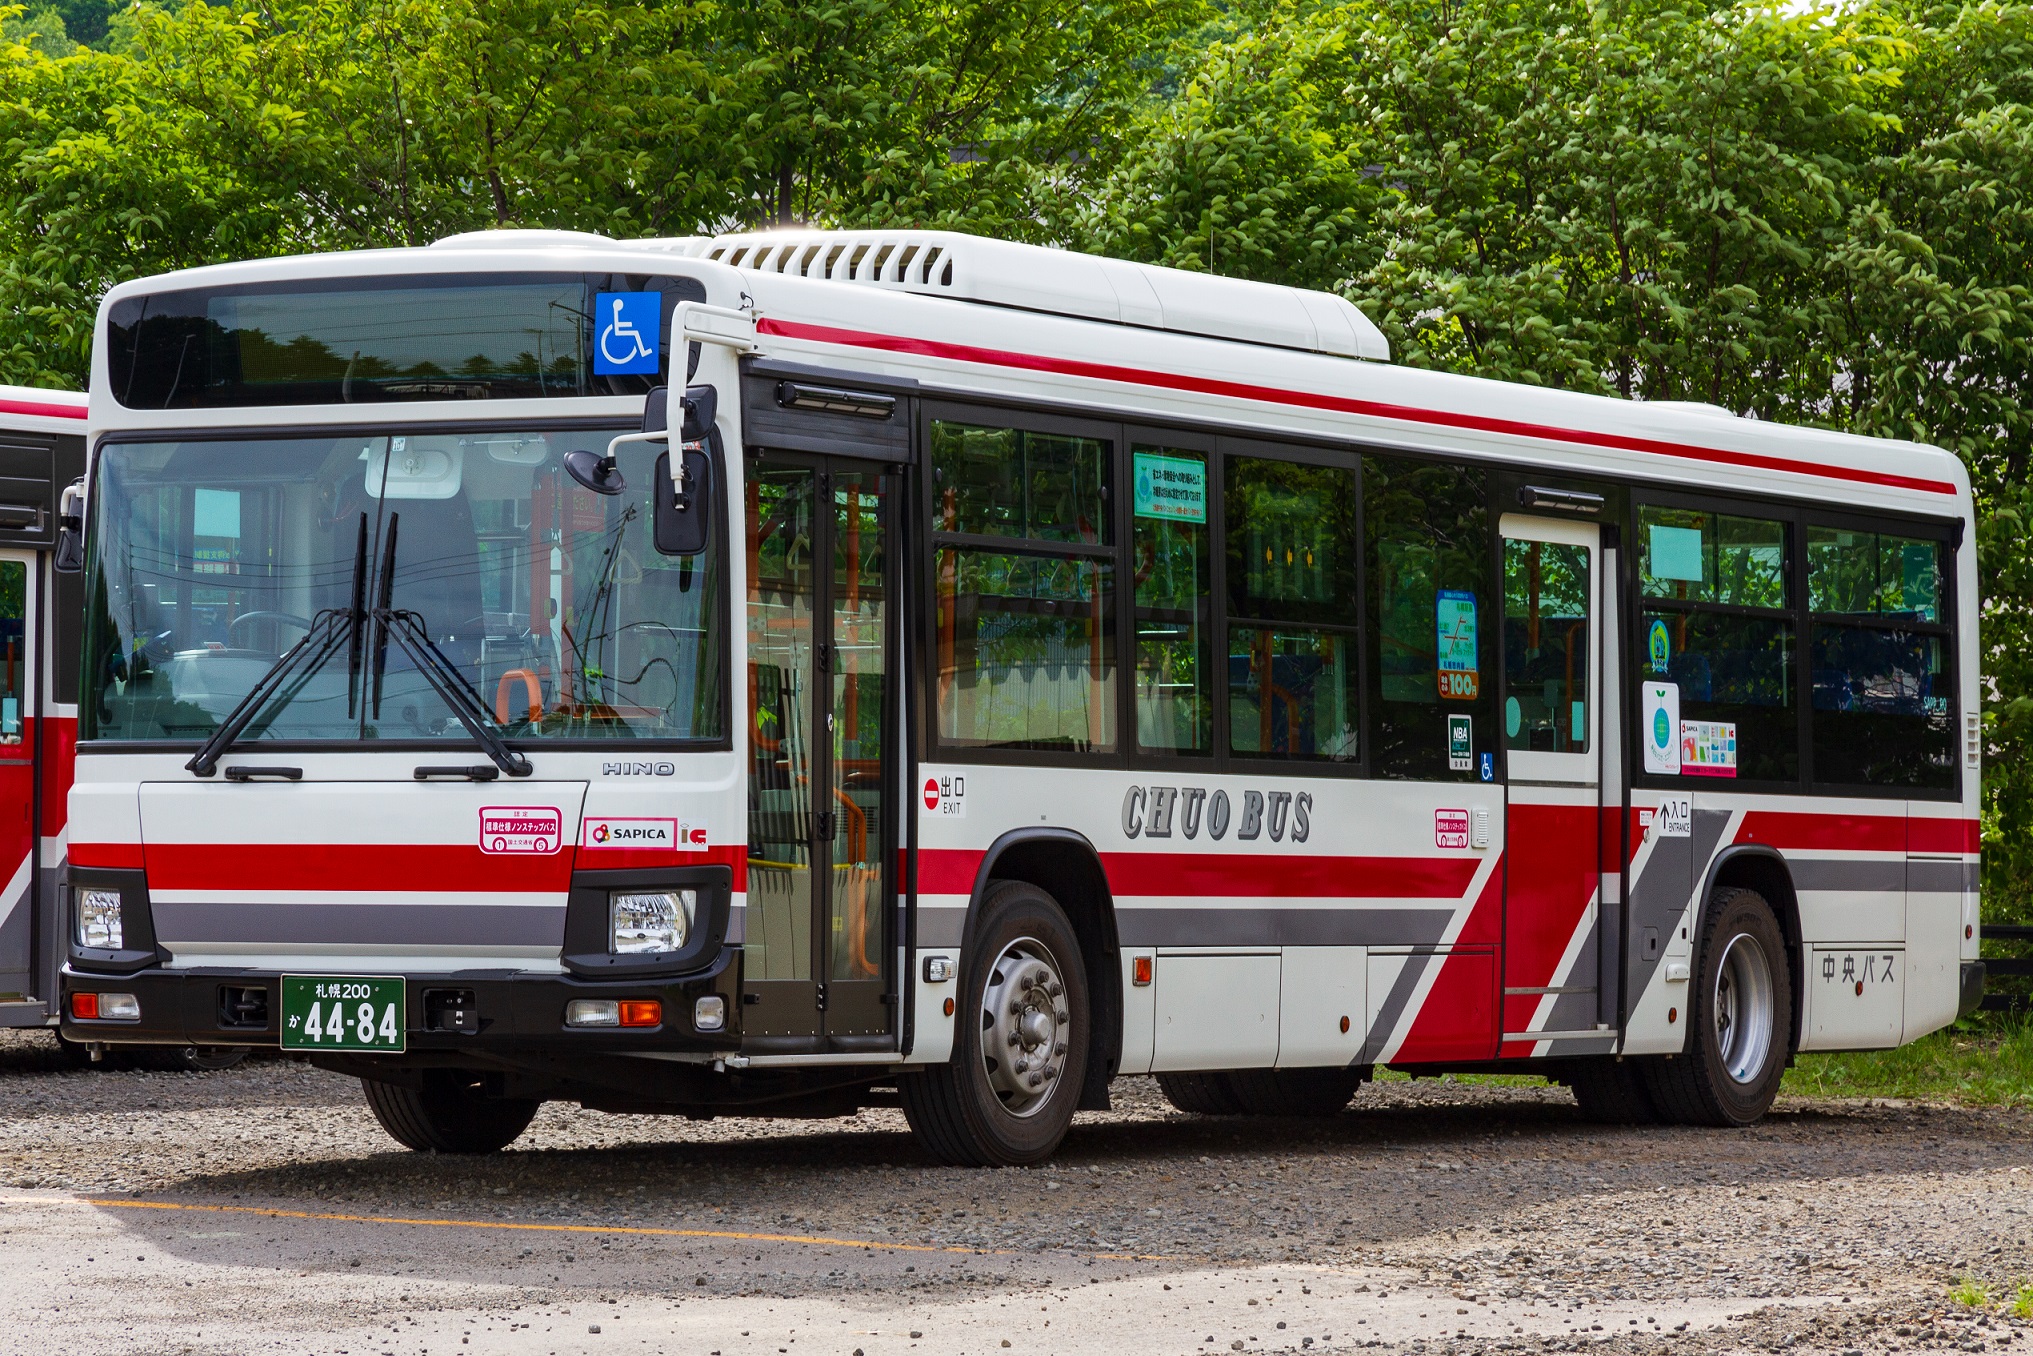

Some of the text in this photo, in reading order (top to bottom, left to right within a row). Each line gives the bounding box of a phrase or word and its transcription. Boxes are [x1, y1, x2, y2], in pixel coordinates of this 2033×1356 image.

[1453, 727, 1468, 740] NBA
[1686, 725, 1698, 733] SAPICA
[603, 762, 675, 776] HINO
[940, 776, 965, 798] 出口
[943, 802, 961, 815] EXIT
[1121, 785, 1314, 843] CHUO BUS
[1671, 801, 1688, 818] 入口
[485, 821, 556, 832] 標準仕様ノンステップバス
[1668, 822, 1690, 833] ENTRANCE
[613, 828, 667, 840] SAPICA
[1822, 953, 1894, 984] 中央バス
[288, 1001, 398, 1044] か 44-84
